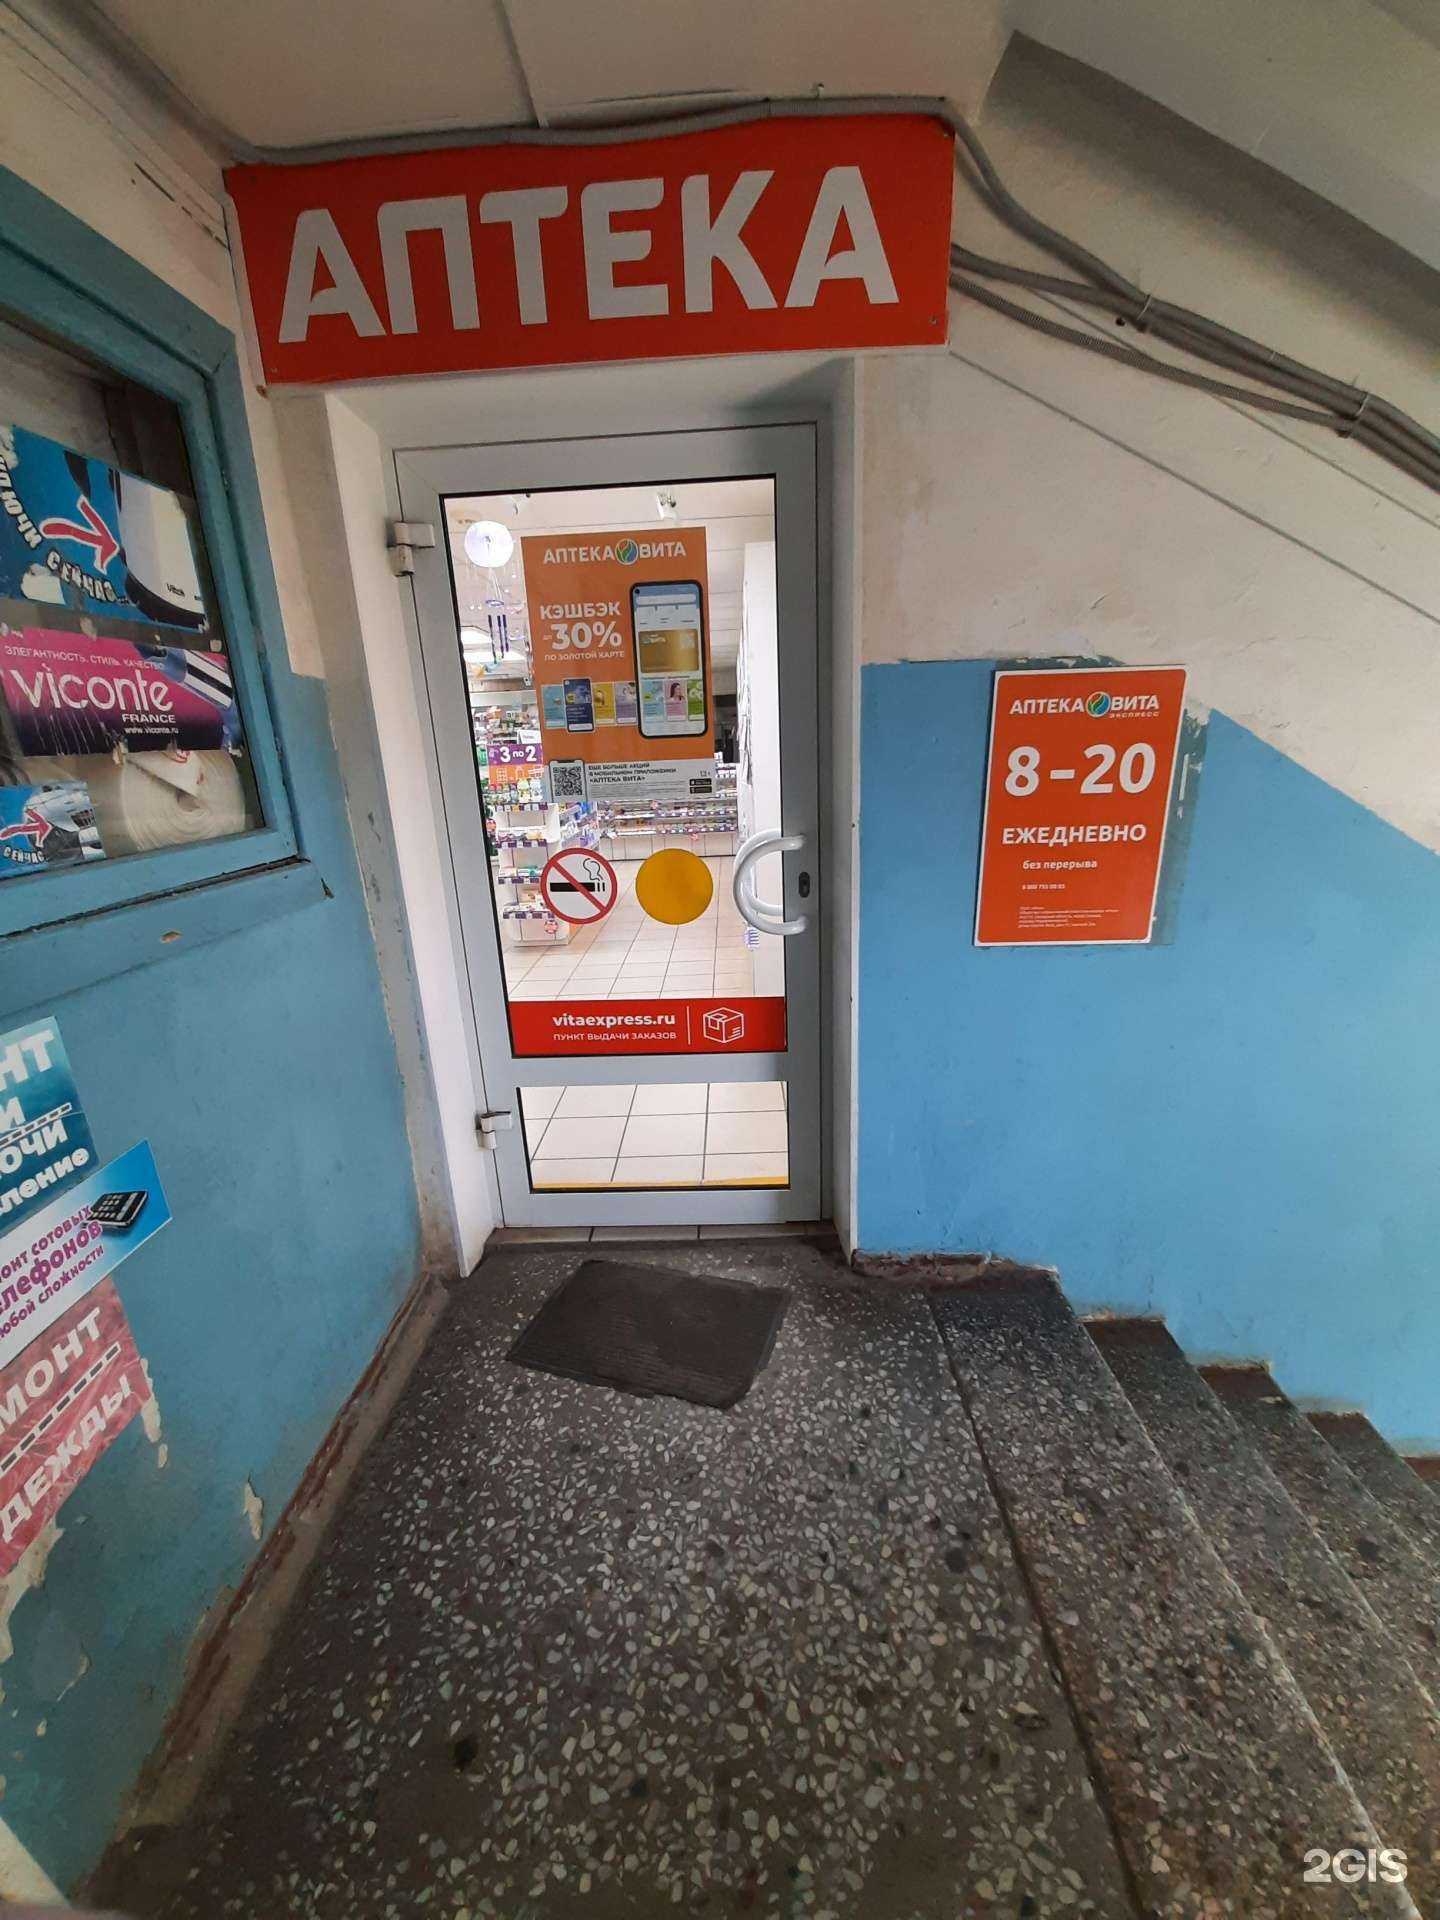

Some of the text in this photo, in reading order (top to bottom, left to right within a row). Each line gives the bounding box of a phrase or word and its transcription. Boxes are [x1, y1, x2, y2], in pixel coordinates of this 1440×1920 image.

[278, 165, 900, 343] АПТЕКА
[543, 541, 687, 564] АПТЕКА ВИТА
[540, 601, 621, 620] КЭШБЭК
[544, 653, 557, 661] ПО
[9, 663, 174, 711] viconte
[1009, 695, 1160, 714] АПТЕКА ВИТА
[121, 713, 177, 724] FRANCE
[500, 745, 537, 763] 3 по 2
[1002, 824, 1147, 847] ЕЖЕДНЕВНО
[1022, 860, 1098, 871] без перерыва
[552, 1013, 676, 1028] vitaexpress.ru
[553, 1031, 677, 1041] ПУНКТ ВЫДАЧИ ЗАКАЗОВ
[0, 1221, 102, 1315] лефонов
